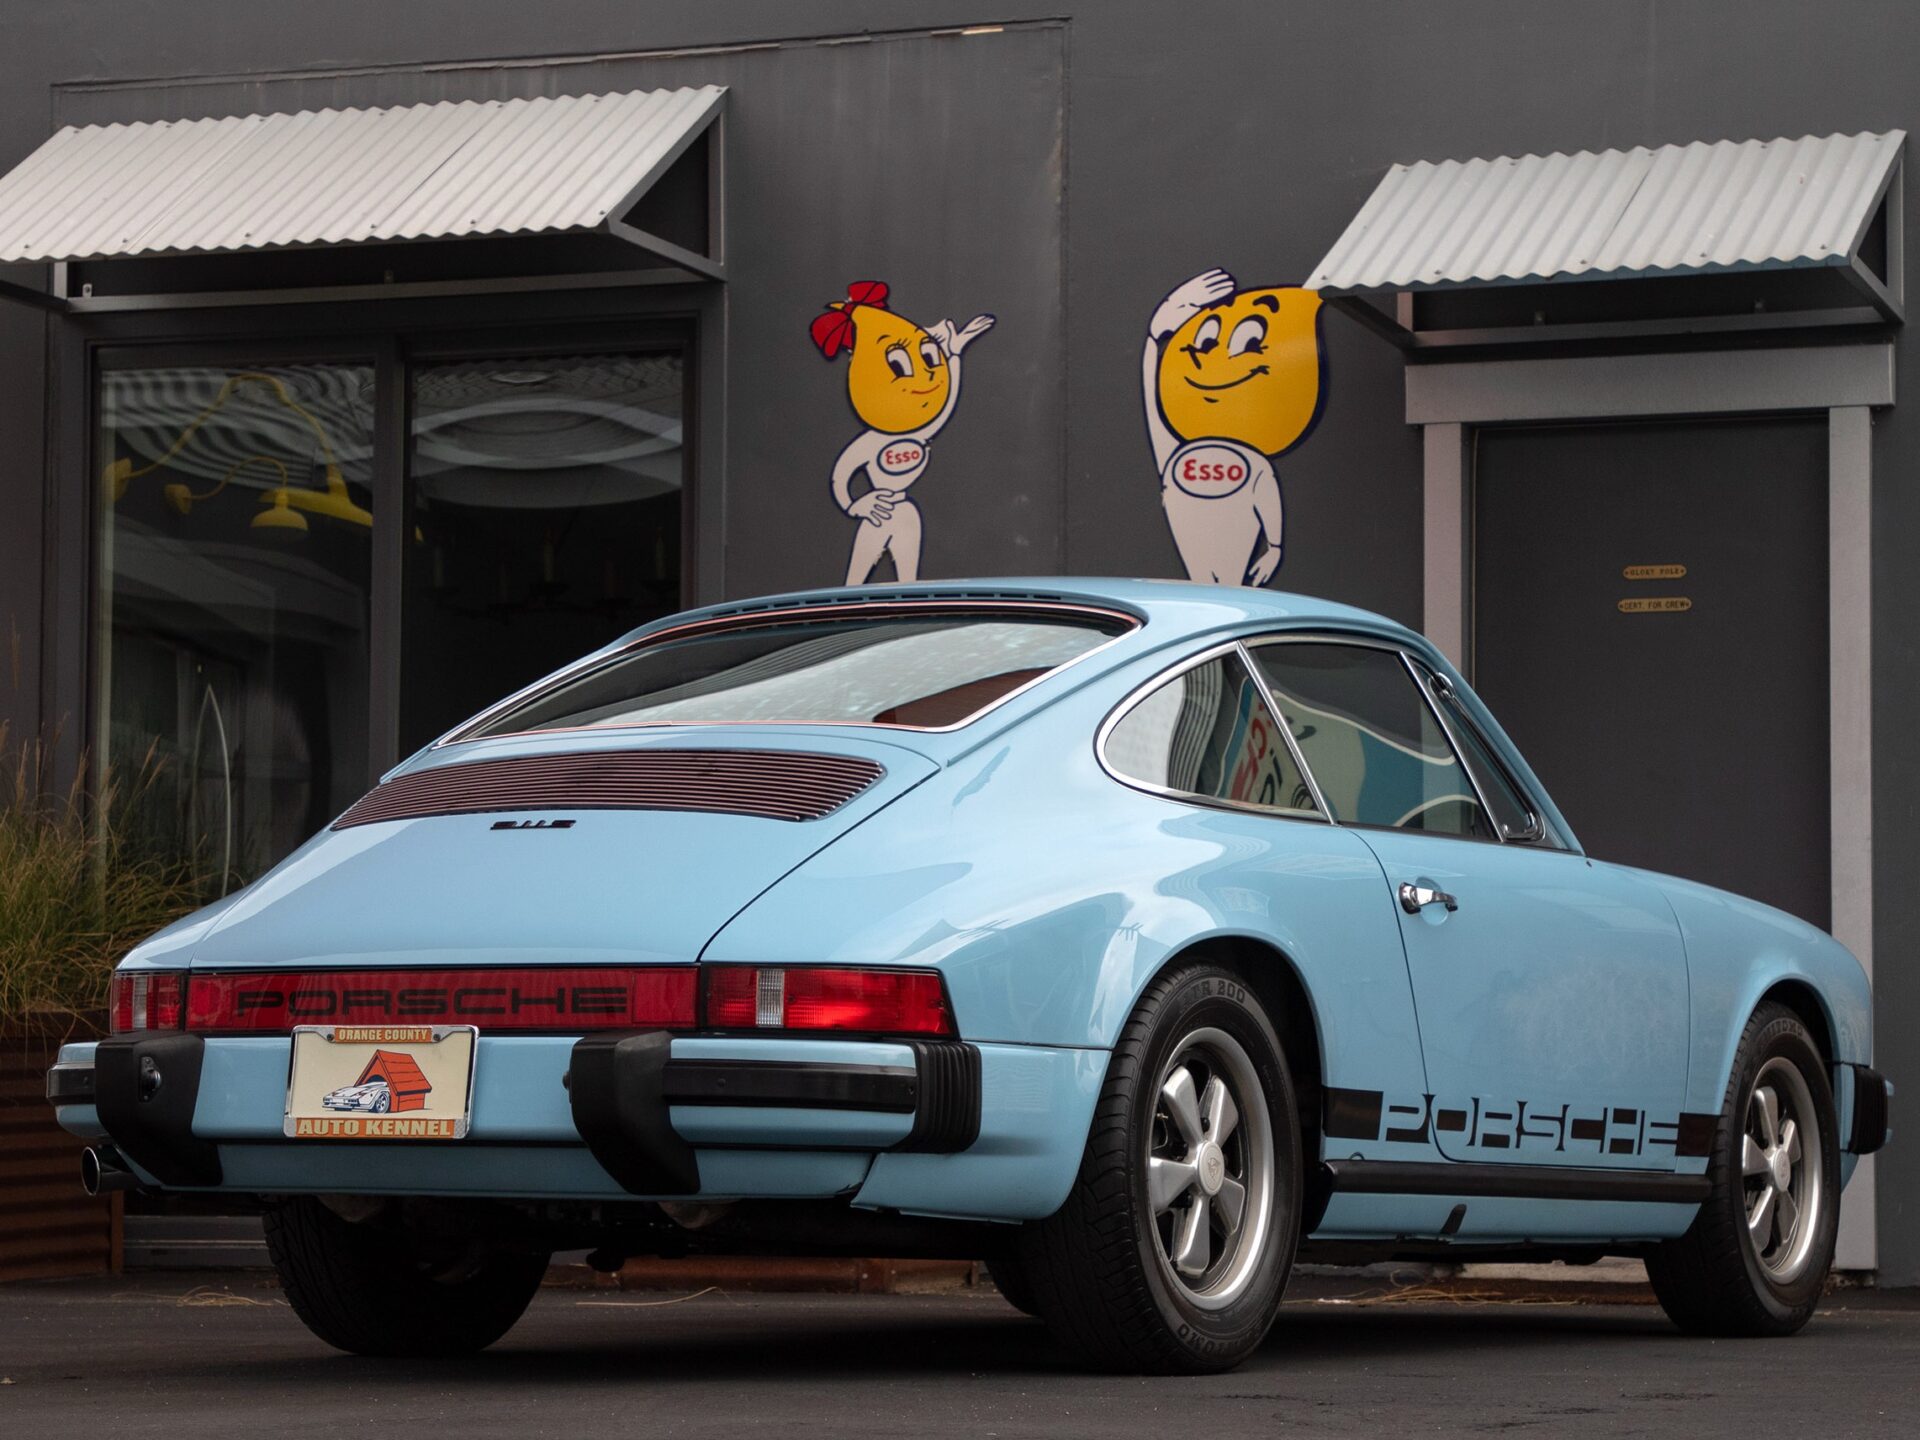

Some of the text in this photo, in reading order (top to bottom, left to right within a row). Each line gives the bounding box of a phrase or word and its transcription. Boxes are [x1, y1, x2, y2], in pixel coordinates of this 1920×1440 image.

[235, 985, 628, 1017] PORSCHE
[1216, 979, 1246, 1004] 200
[338, 1028, 428, 1041] ORANGE COUNTY
[299, 1118, 451, 1136] AUTO KENNEL
[1379, 1091, 1681, 1157] PORSCHE
